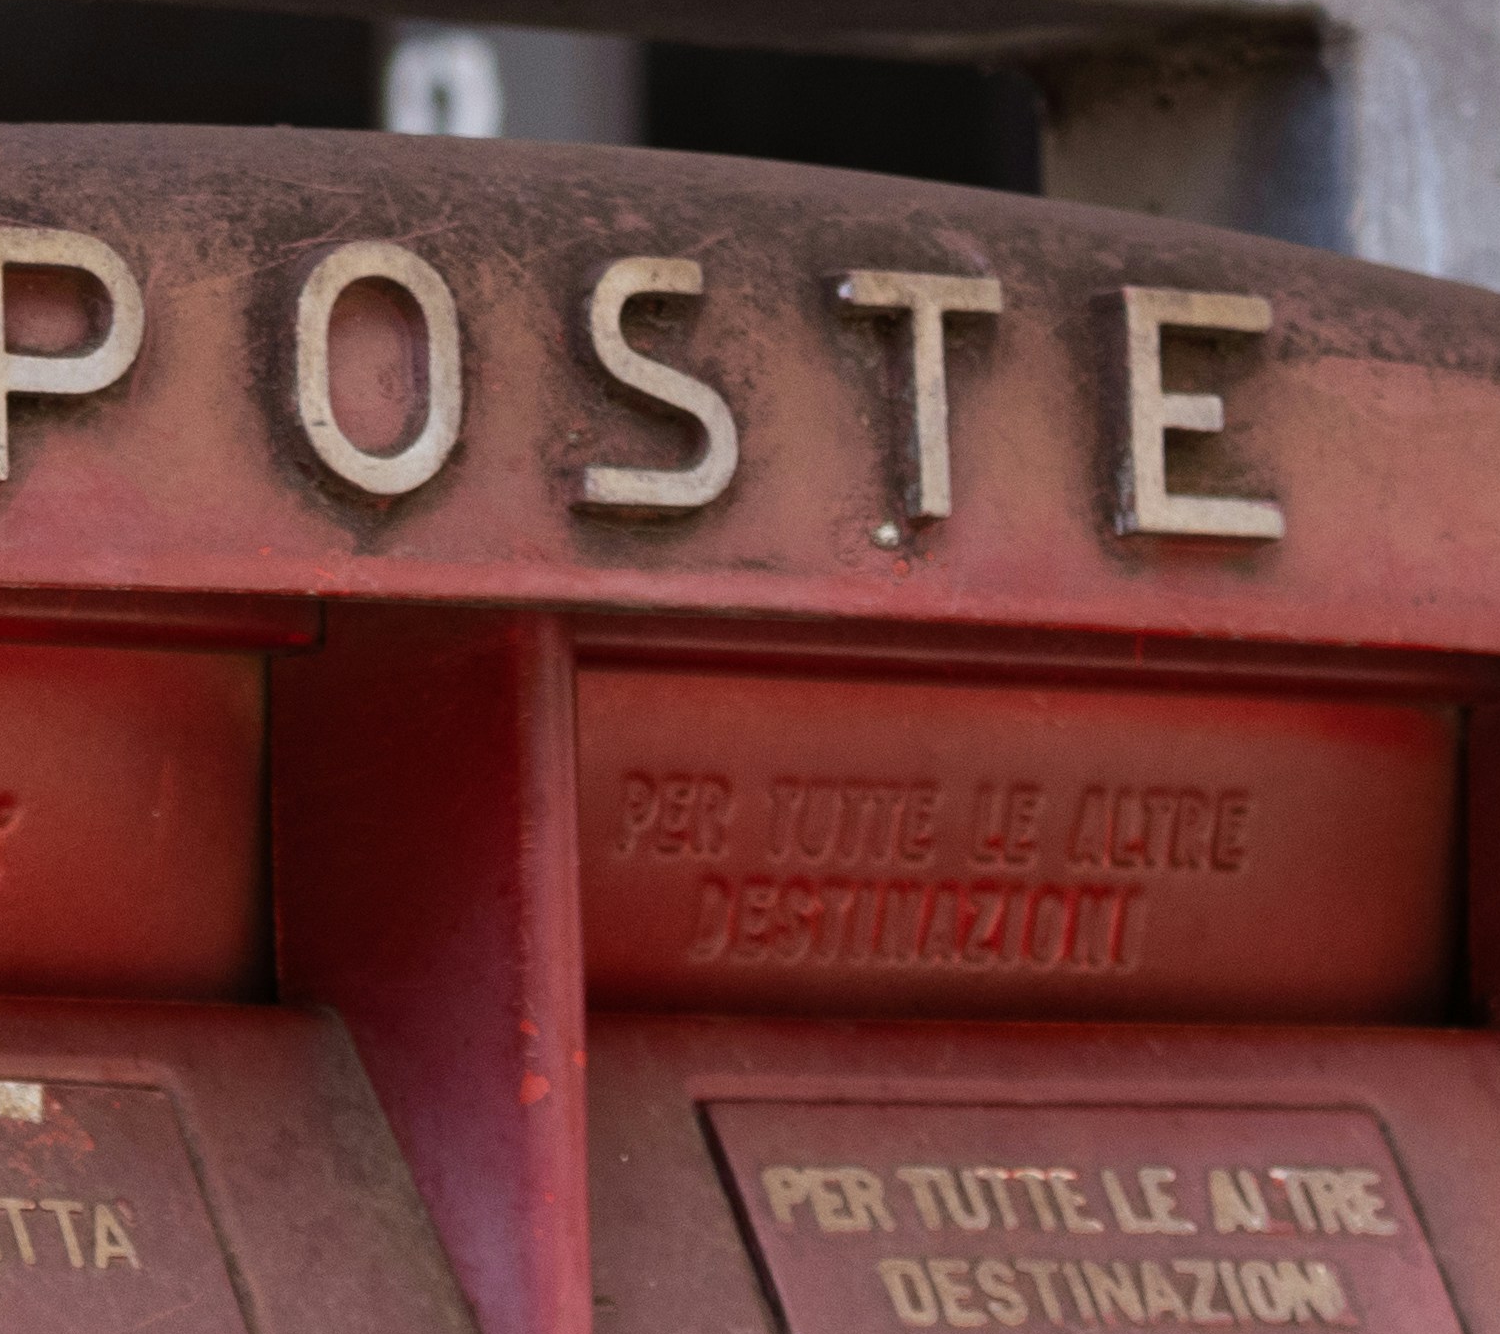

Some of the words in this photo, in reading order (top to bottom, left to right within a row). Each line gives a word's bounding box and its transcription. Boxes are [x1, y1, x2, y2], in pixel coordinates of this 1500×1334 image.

[616, 771, 735, 859] PER
[768, 775, 940, 864] TUTTE
[974, 777, 1043, 866] LE
[1069, 783, 1252, 870] ALTRE
[762, 1167, 896, 1233] PER
[898, 1166, 1105, 1233] TUTTE
[1103, 1167, 1198, 1235] LE
